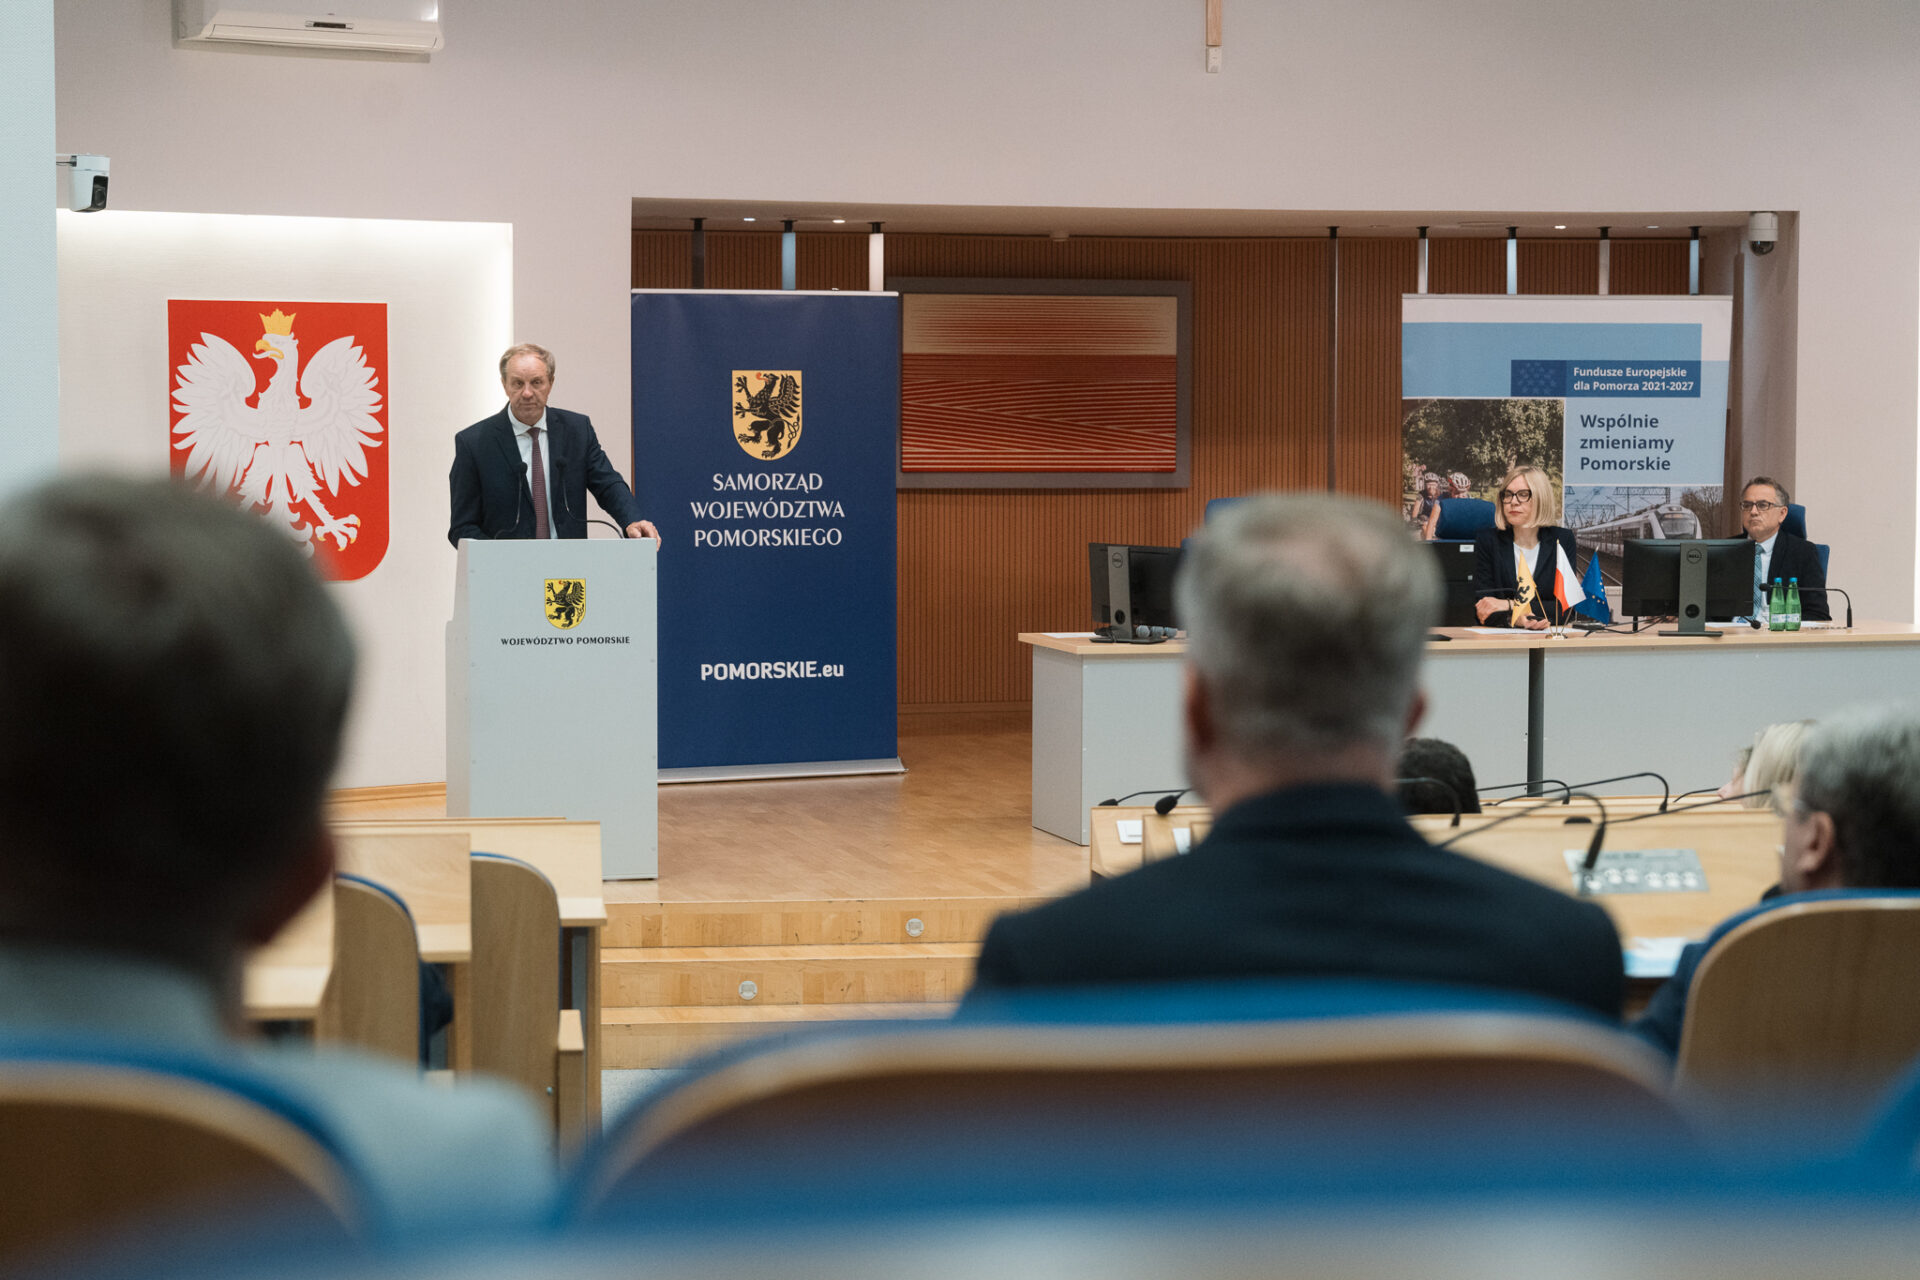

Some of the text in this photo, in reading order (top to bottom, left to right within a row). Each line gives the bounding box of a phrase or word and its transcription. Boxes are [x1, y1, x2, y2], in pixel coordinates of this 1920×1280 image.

[1573, 367, 1687, 379] Fundusze Europejskie
[1573, 380, 1694, 391] dla Pomorza 2021-2027
[1580, 414, 1659, 431] Wspólnie
[1580, 435, 1674, 453] zmieniamy
[1580, 457, 1671, 470] Pomorskie
[712, 472, 823, 494] SAMORZĄD
[690, 497, 845, 519] WOJEWÓDZTWA
[694, 527, 842, 547] POMORSKIEGO
[500, 636, 631, 646] WOJEWÓDZTWO POMORSKIE
[700, 660, 845, 681] POMORSKIE.eu
